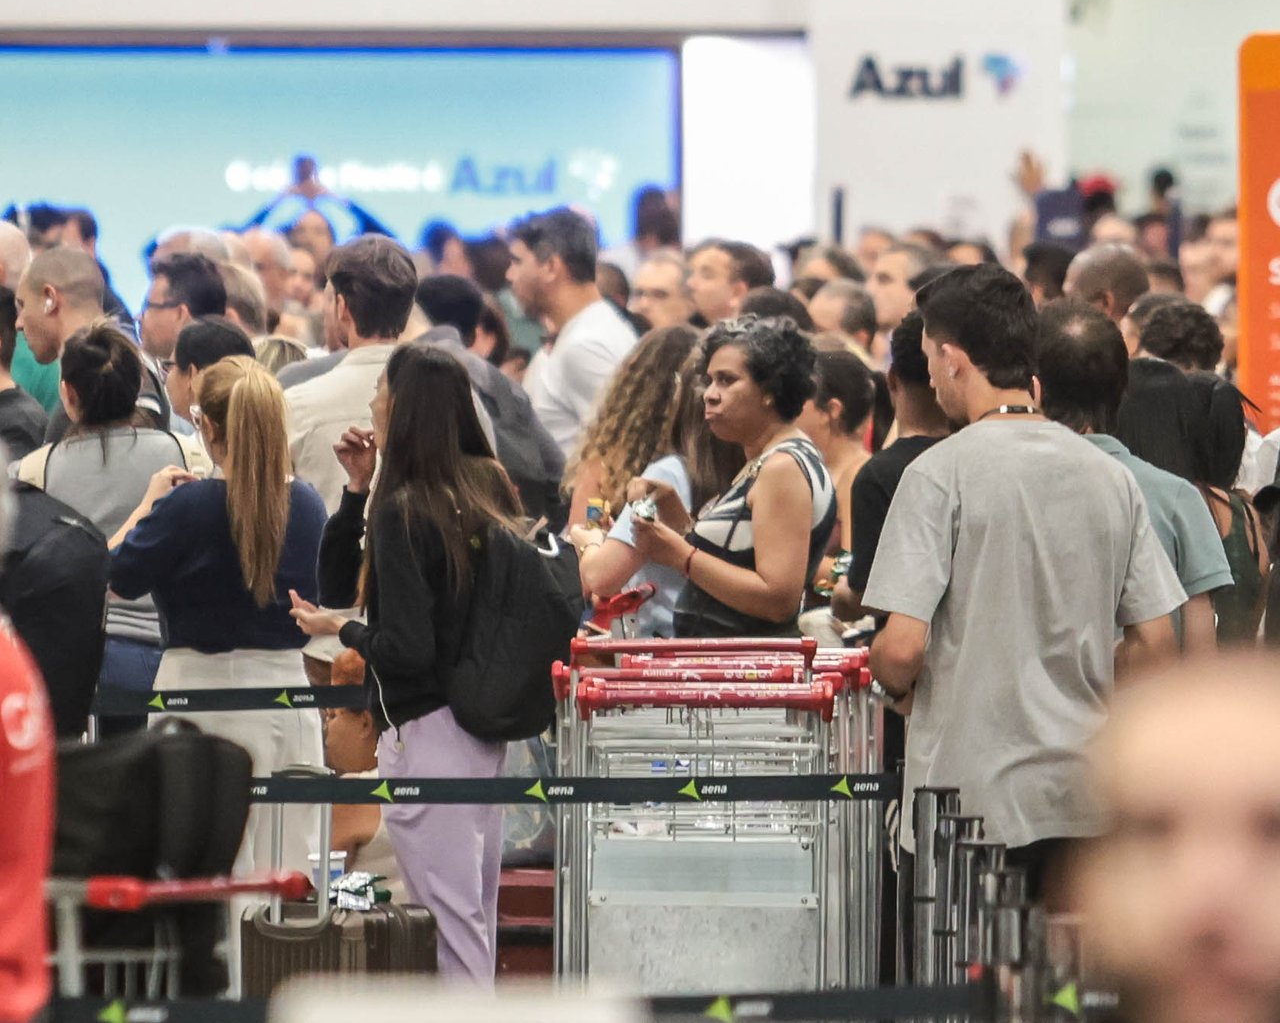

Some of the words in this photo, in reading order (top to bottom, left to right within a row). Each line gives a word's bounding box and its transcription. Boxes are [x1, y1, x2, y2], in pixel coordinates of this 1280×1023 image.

[849, 55, 963, 99] Azul
[393, 785, 419, 797] aena
[547, 784, 573, 796] aena
[701, 783, 727, 795] aena
[853, 781, 879, 793] aena
